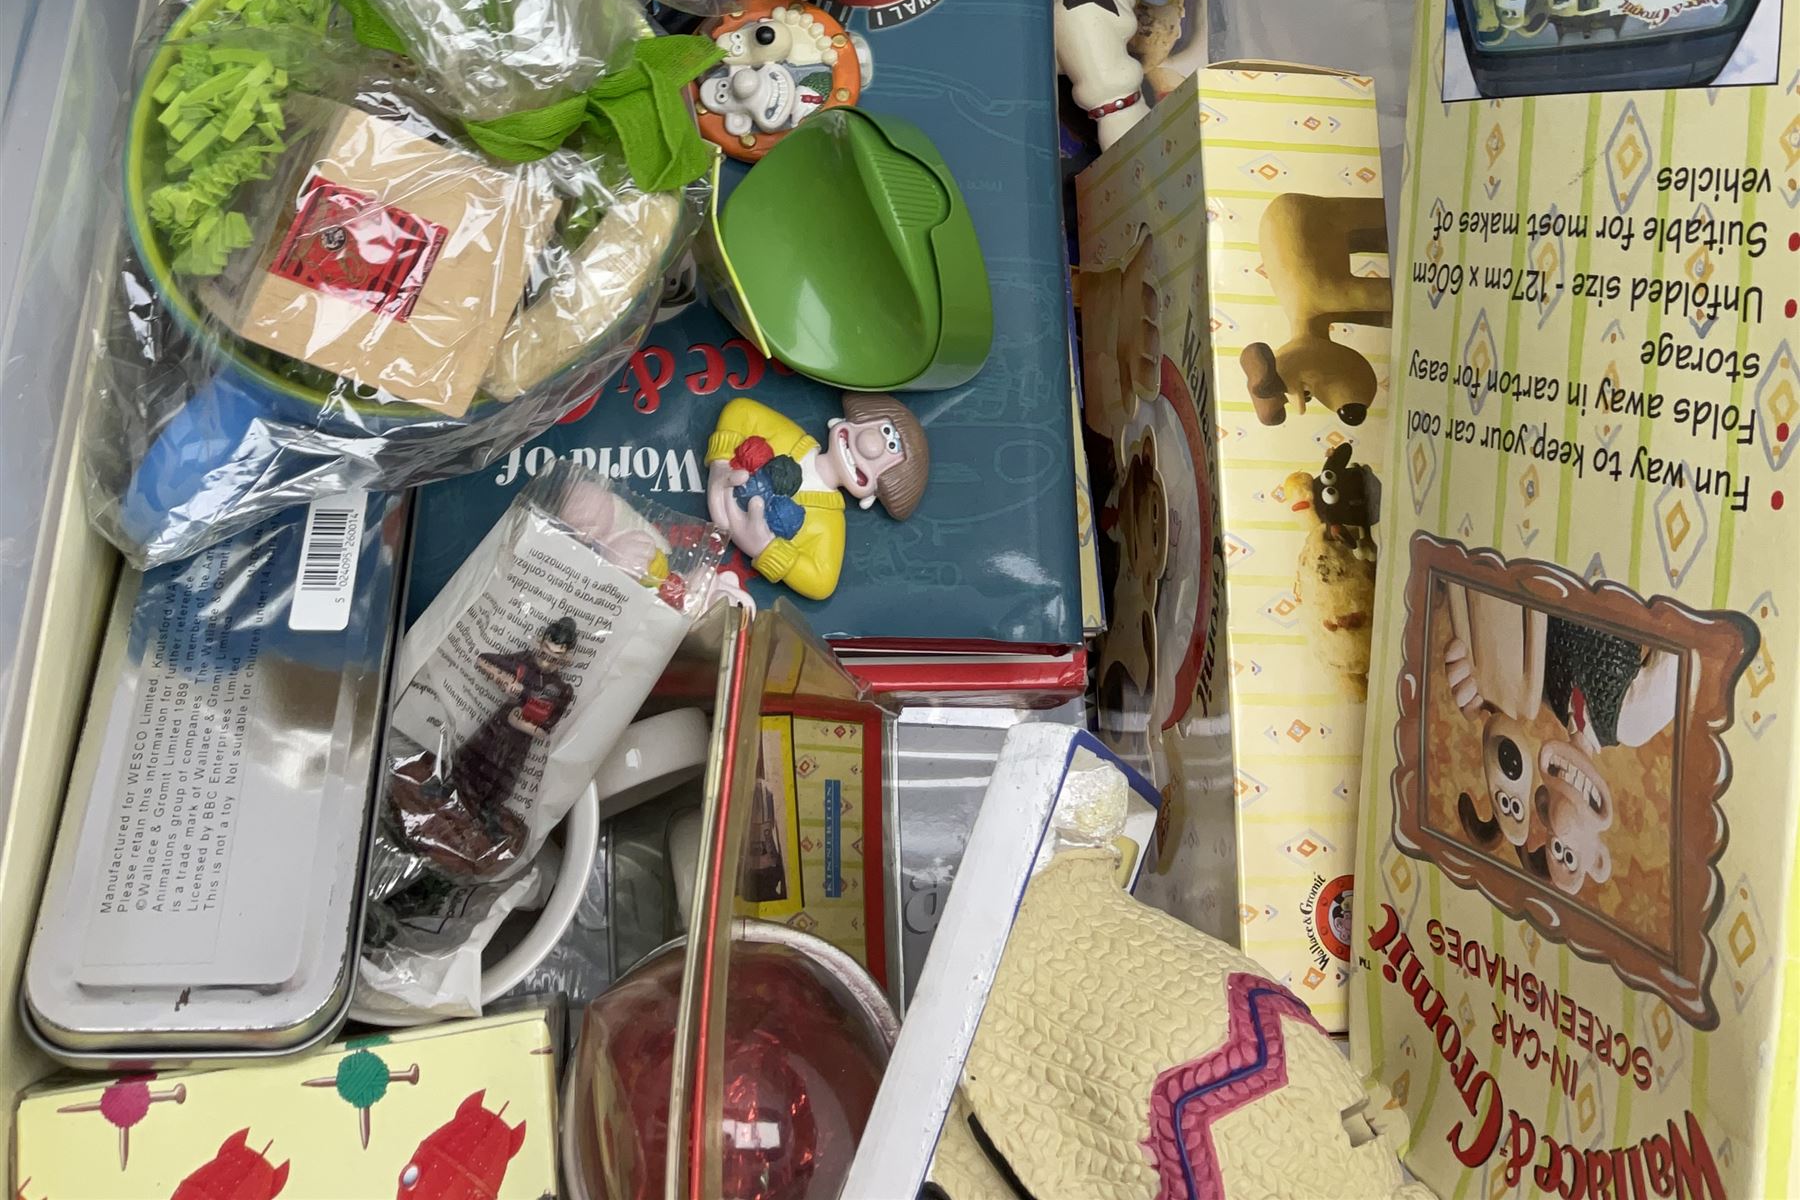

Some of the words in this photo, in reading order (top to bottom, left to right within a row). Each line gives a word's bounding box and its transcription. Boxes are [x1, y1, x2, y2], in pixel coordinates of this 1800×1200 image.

[1657, 167, 1772, 203] vehicles
[1432, 210, 1454, 241] of
[1459, 211, 1519, 242] makes
[1527, 213, 1589, 239] most
[1597, 217, 1635, 250] for
[1644, 218, 1768, 257] Suitable
[1413, 261, 1463, 294] 60cm
[1485, 270, 1547, 304] 127cm
[1572, 273, 1620, 307] size
[1632, 278, 1763, 323] Unfolded
[1409, 349, 1448, 382] easy
[1641, 332, 1761, 383] storage
[1454, 366, 1481, 398] for
[1487, 369, 1560, 401] carton
[1567, 382, 1588, 416] in
[1596, 378, 1663, 418] away
[1407, 409, 1441, 440] cool
[1446, 417, 1475, 442] car
[1480, 422, 1526, 454] your
[1675, 400, 1756, 445] Folds
[1533, 422, 1584, 478] keep
[1594, 447, 1622, 481] to
[1631, 447, 1683, 490] way
[1695, 466, 1750, 512] Fun
[338, 552, 351, 586] 024095
[346, 512, 358, 546] 260014
[508, 554, 545, 581] confezi
[213, 550, 230, 590] Gromit
[175, 574, 194, 633] reference
[254, 590, 269, 624] under
[184, 612, 202, 661] member
[201, 607, 219, 656] Wallace
[216, 614, 233, 661] Limited
[165, 637, 182, 680] further
[243, 627, 262, 678] children
[161, 684, 173, 702] for
[194, 661, 209, 686] The
[207, 664, 224, 708] Gromit
[223, 655, 242, 703] Limited
[239, 682, 252, 700] for
[143, 705, 169, 782] information
[163, 717, 182, 767] Limited
[208, 707, 233, 785] Enterprises
[229, 704, 250, 758] suitable
[125, 729, 148, 786] WESCO
[193, 726, 213, 781] Wallace
[224, 761, 240, 786] Not
[152, 770, 172, 818] Gromit
[176, 769, 189, 783] of
[190, 784, 202, 799] of
[120, 789, 136, 810] for
[137, 785, 153, 813] this
[168, 786, 188, 827] group
[203, 789, 218, 820] BBC
[128, 816, 146, 859] retain
[149, 822, 161, 833] &
[182, 802, 199, 838] mark
[199, 825, 214, 842] by
[99, 812, 131, 914] Manufactured
[175, 842, 192, 881] trade
[212, 833, 227, 856] not
[116, 861, 138, 914] Please
[151, 830, 177, 913] Animations
[186, 845, 209, 913] Licensed
[203, 878, 220, 912] This
[1300, 875, 1326, 915] Gromit
[1305, 926, 1330, 971] Wallace
[1426, 919, 1653, 1091] SCREENSHADES
[1368, 903, 1504, 1168] Gromit
[1492, 1001, 1580, 1101] IN-CAR
[1501, 1110, 1536, 1189] &
[1534, 1110, 1728, 1200] Wallace
